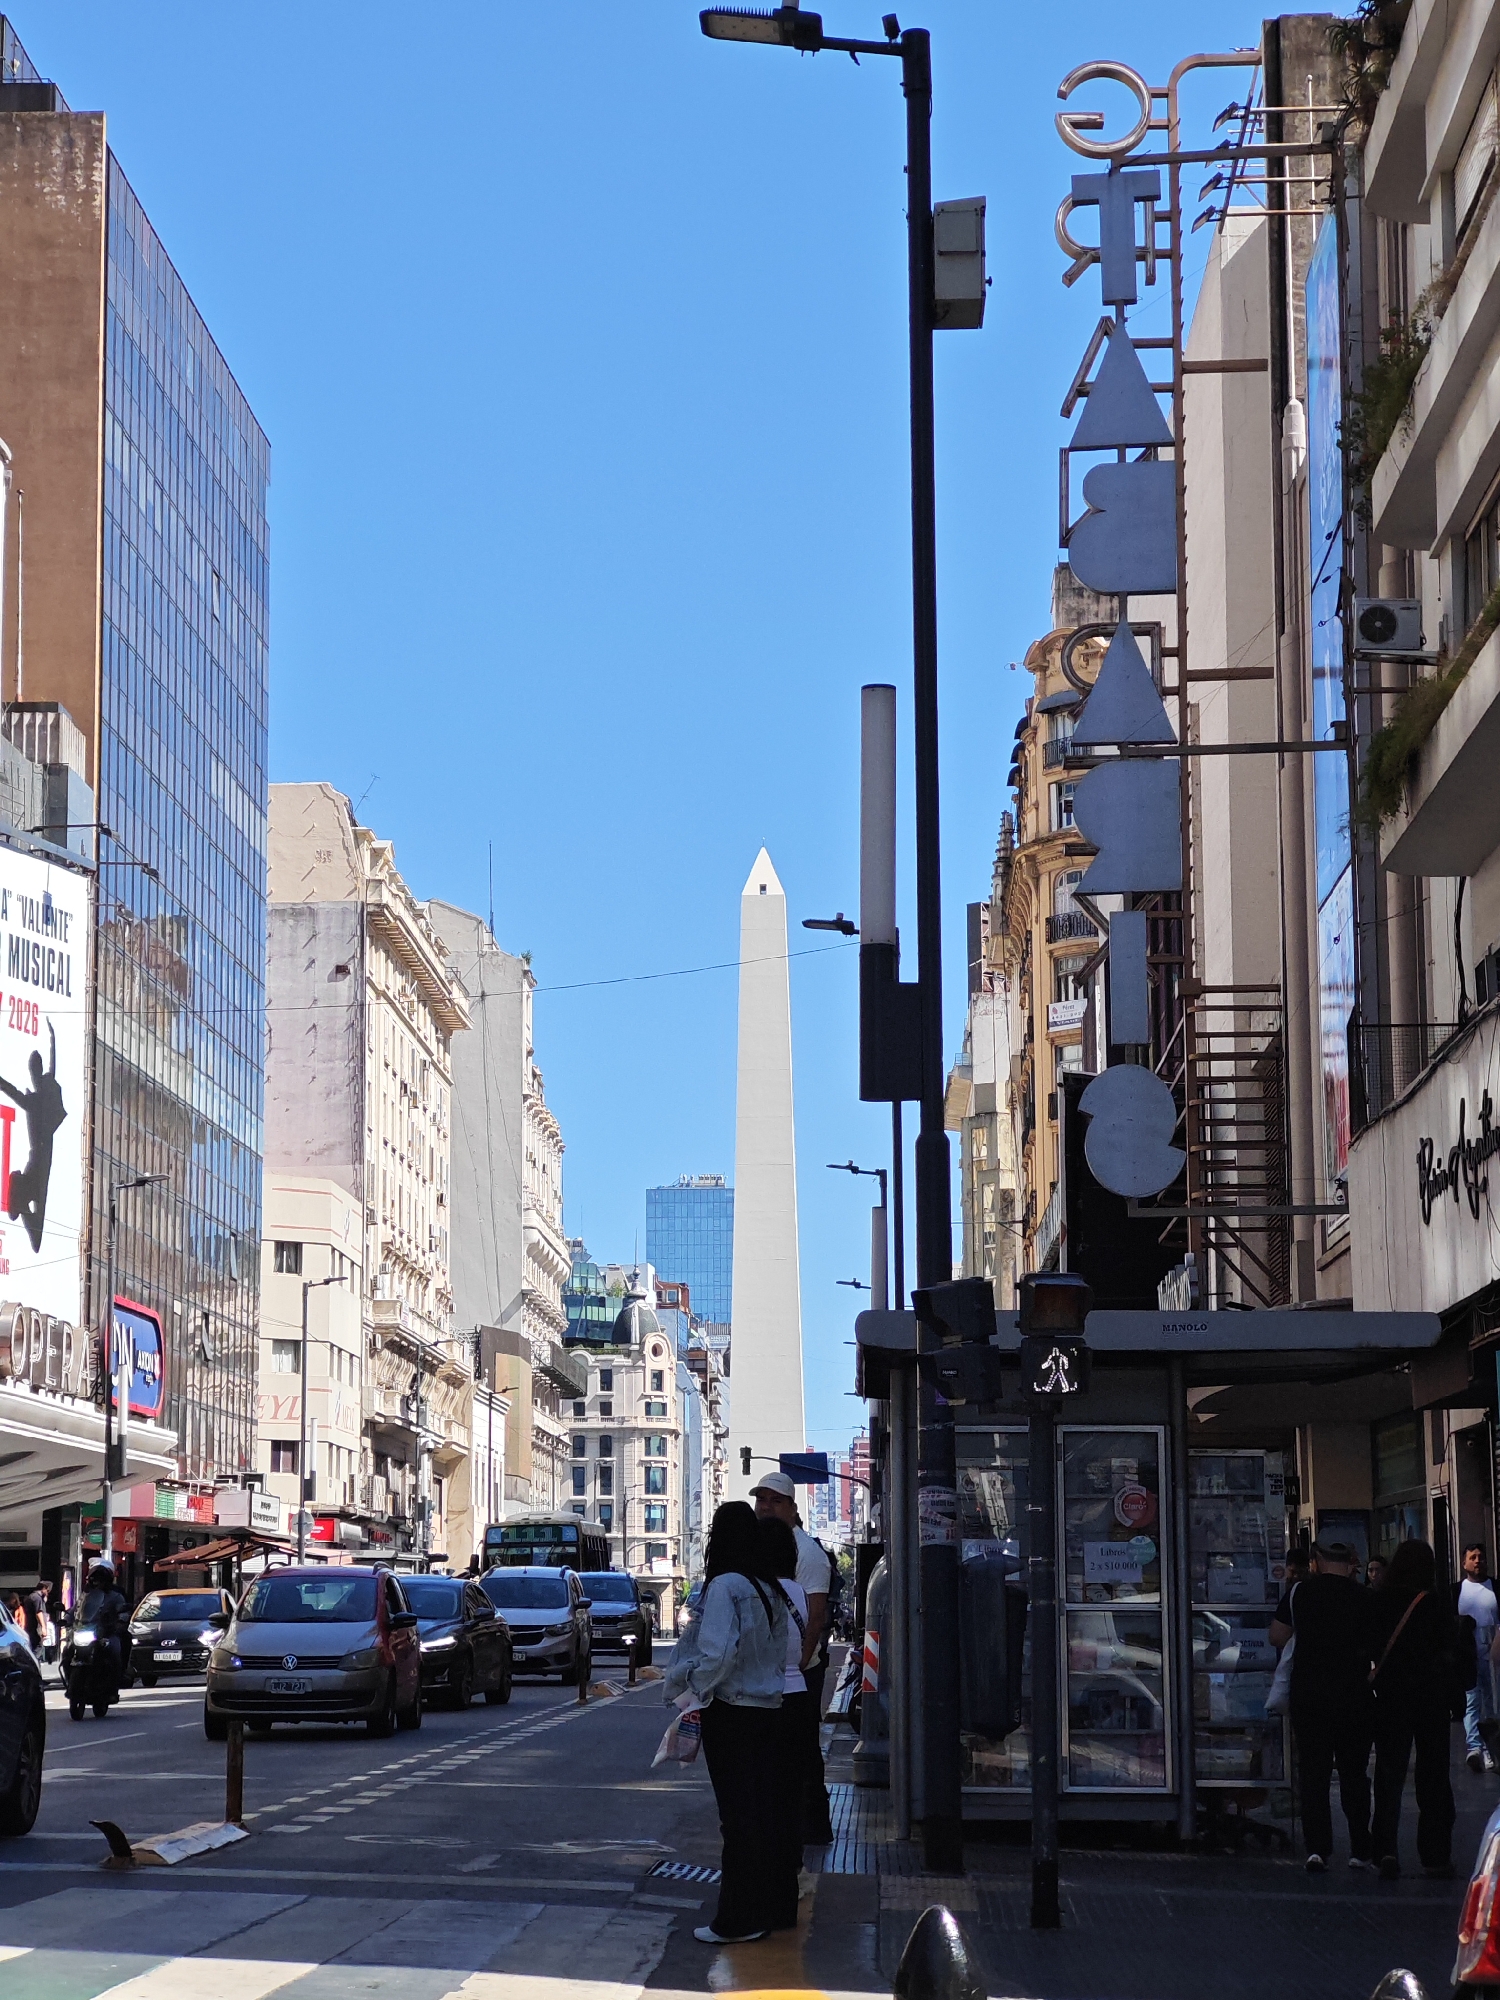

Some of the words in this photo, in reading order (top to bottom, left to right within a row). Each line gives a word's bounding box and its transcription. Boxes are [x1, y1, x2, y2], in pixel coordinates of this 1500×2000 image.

[8, 933, 72, 998] MUSICAL
[8, 995, 39, 1037] 2026
[1162, 1323, 1208, 1332] MANOLO
[0, 1302, 90, 1397] OPERA
[1123, 1499, 1145, 1510] Claro
[503, 1526, 557, 1543] 111
[1100, 1547, 1127, 1557] Libros
[1090, 1562, 1096, 1571] 2
